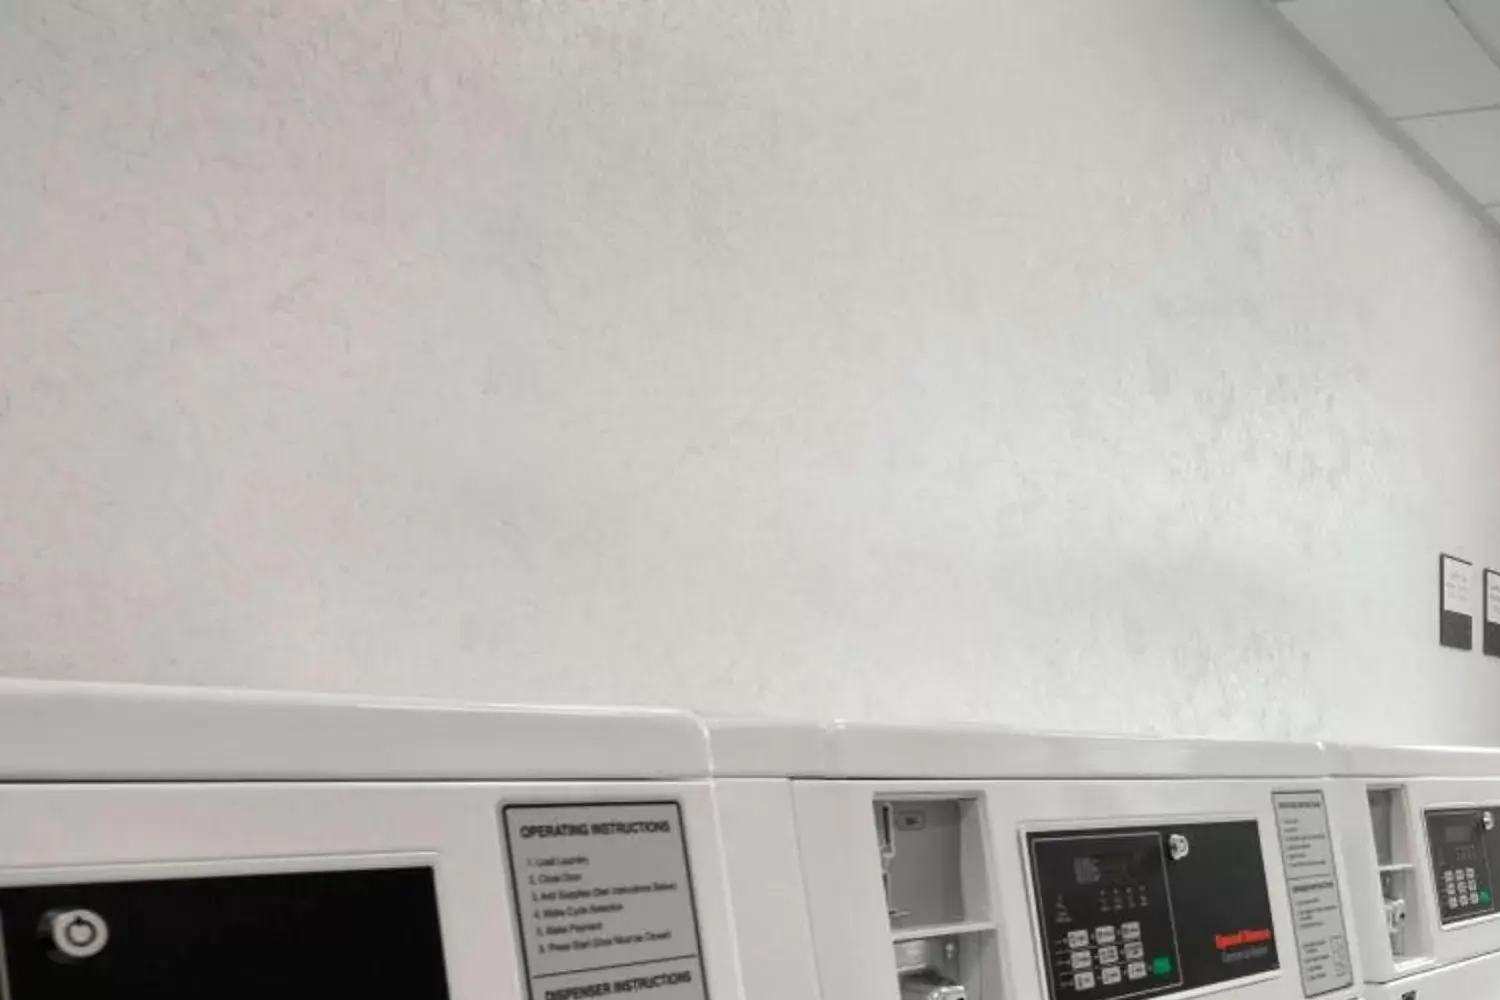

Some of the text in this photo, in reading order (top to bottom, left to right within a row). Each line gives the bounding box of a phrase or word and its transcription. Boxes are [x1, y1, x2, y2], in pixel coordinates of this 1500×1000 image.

[519, 820, 671, 839] OPERATING INSTRUCTIONS
[613, 970, 692, 994] INSTRUCTIONS
